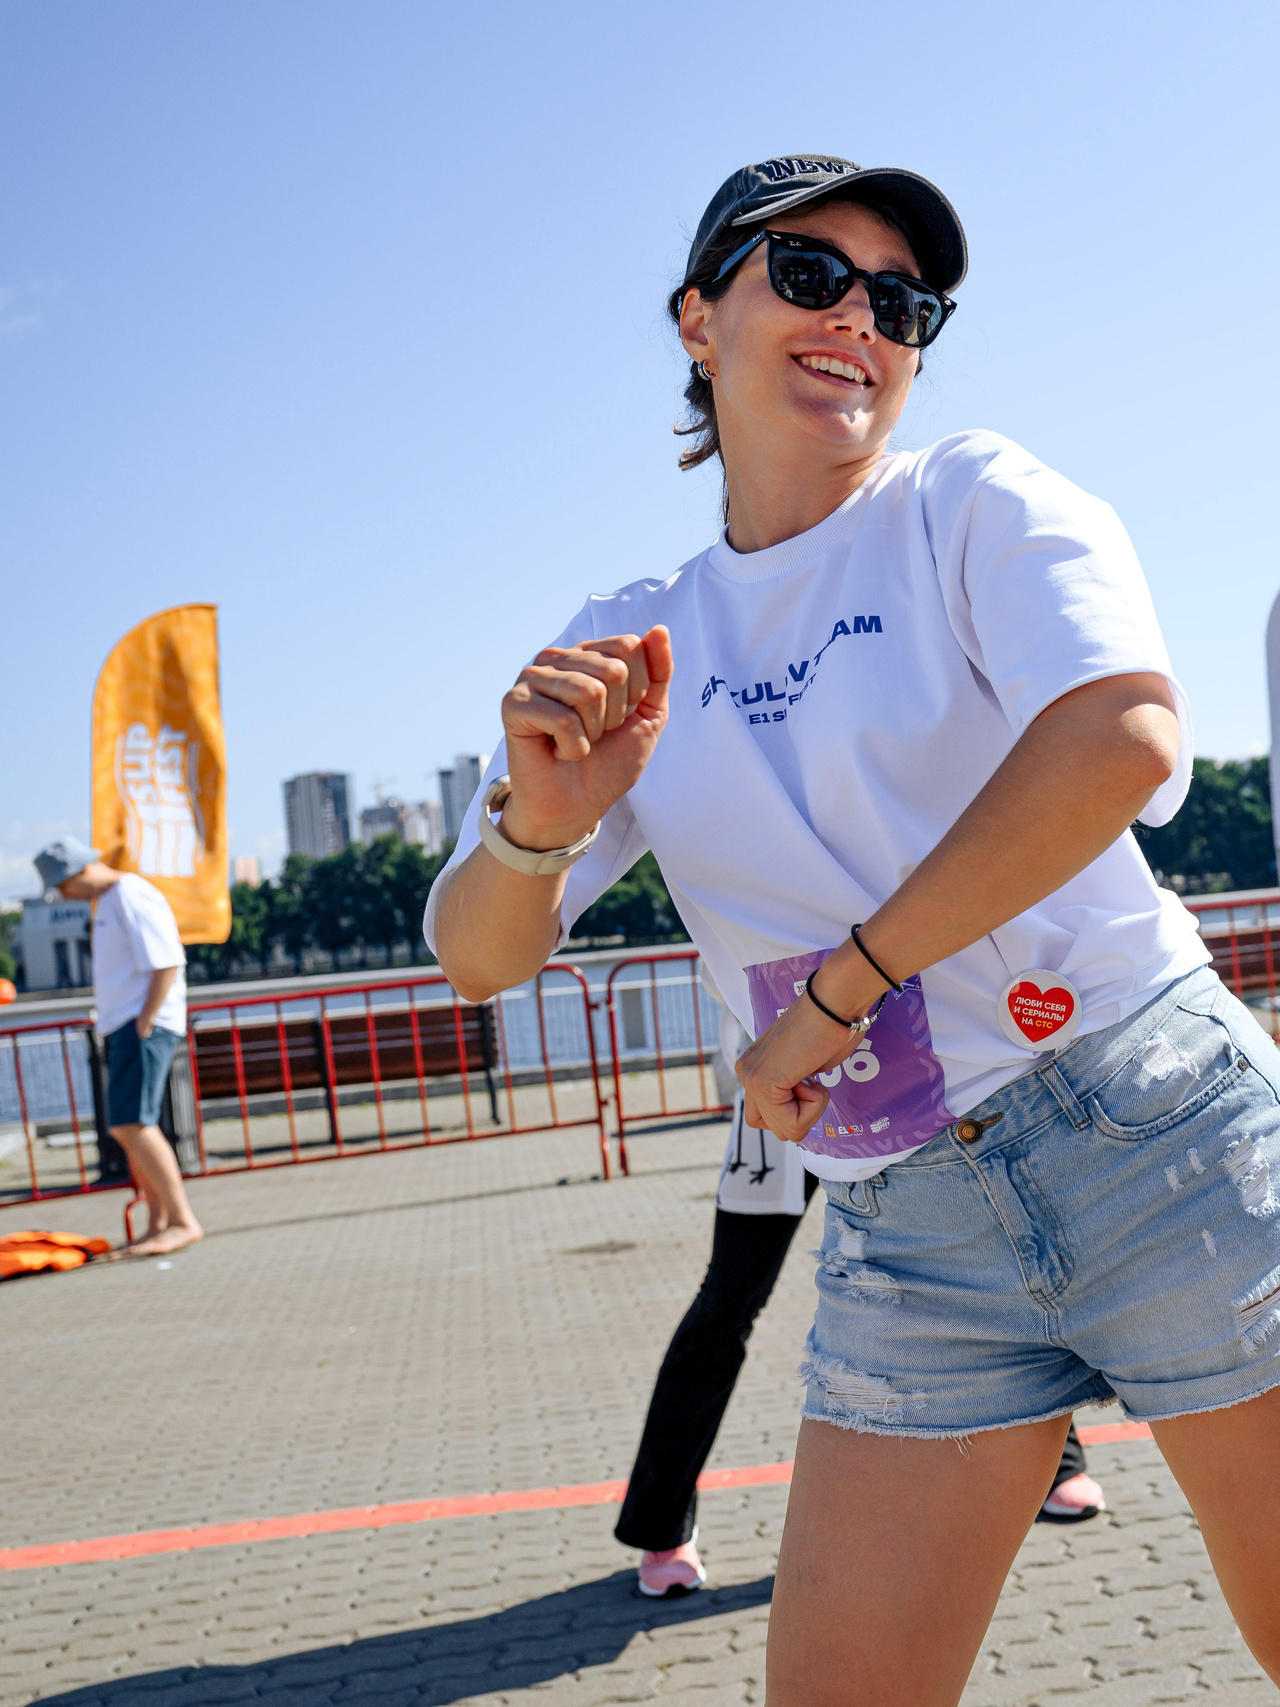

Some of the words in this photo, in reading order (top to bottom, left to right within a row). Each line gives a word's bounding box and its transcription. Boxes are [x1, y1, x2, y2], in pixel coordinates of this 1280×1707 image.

[1015, 996, 1043, 1008] ЛЮБИ
[1044, 1002, 1066, 1012] СЕБЯ
[1014, 1006, 1021, 1014] И
[1022, 1008, 1065, 1022] СЕРИАЛЫ
[1021, 1017, 1034, 1025] НА
[1035, 1020, 1053, 1029] СТС
